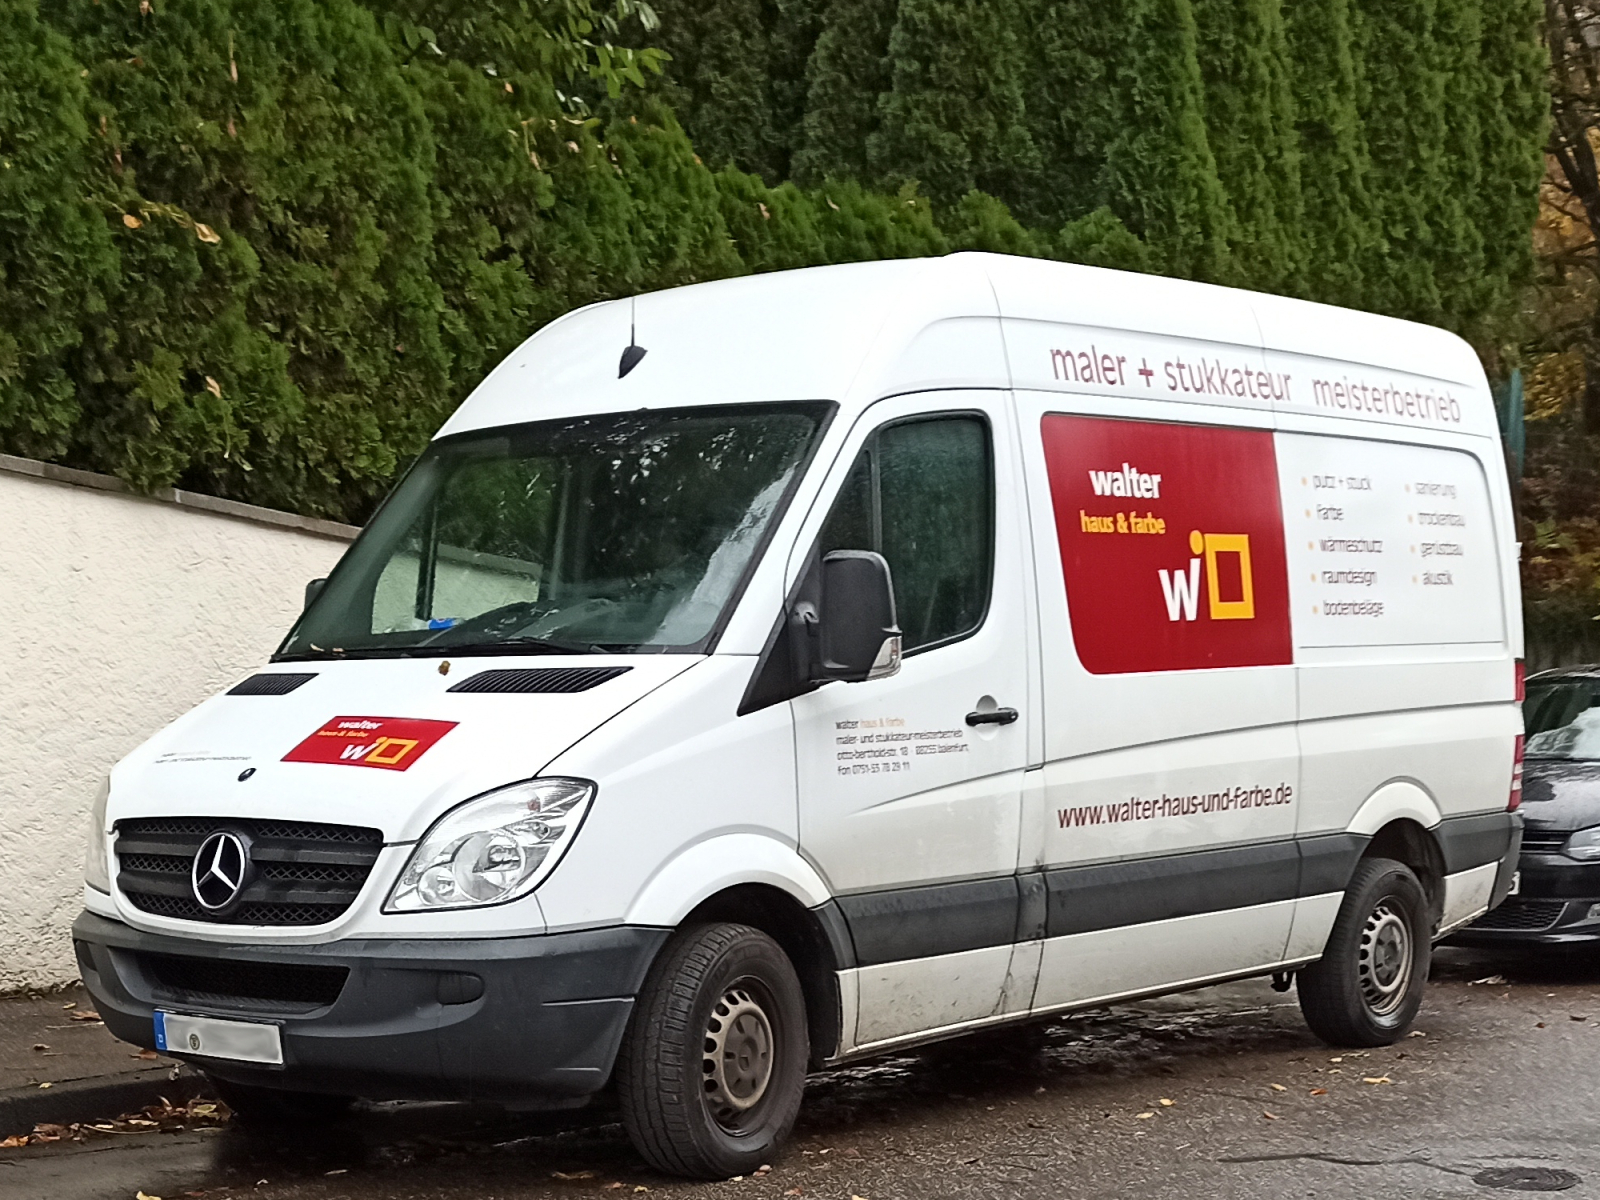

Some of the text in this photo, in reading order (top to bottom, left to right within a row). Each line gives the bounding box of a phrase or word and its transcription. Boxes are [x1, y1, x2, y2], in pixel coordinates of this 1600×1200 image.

[1050, 345, 1127, 385] maler
[1164, 356, 1293, 401] stukkateur
[1312, 375, 1461, 422] meisterbetrieb
[1088, 462, 1162, 499] walter
[1079, 509, 1166, 534] haus & farbe
[1057, 782, 1293, 829] www.walter-haus-und-farbe.de
